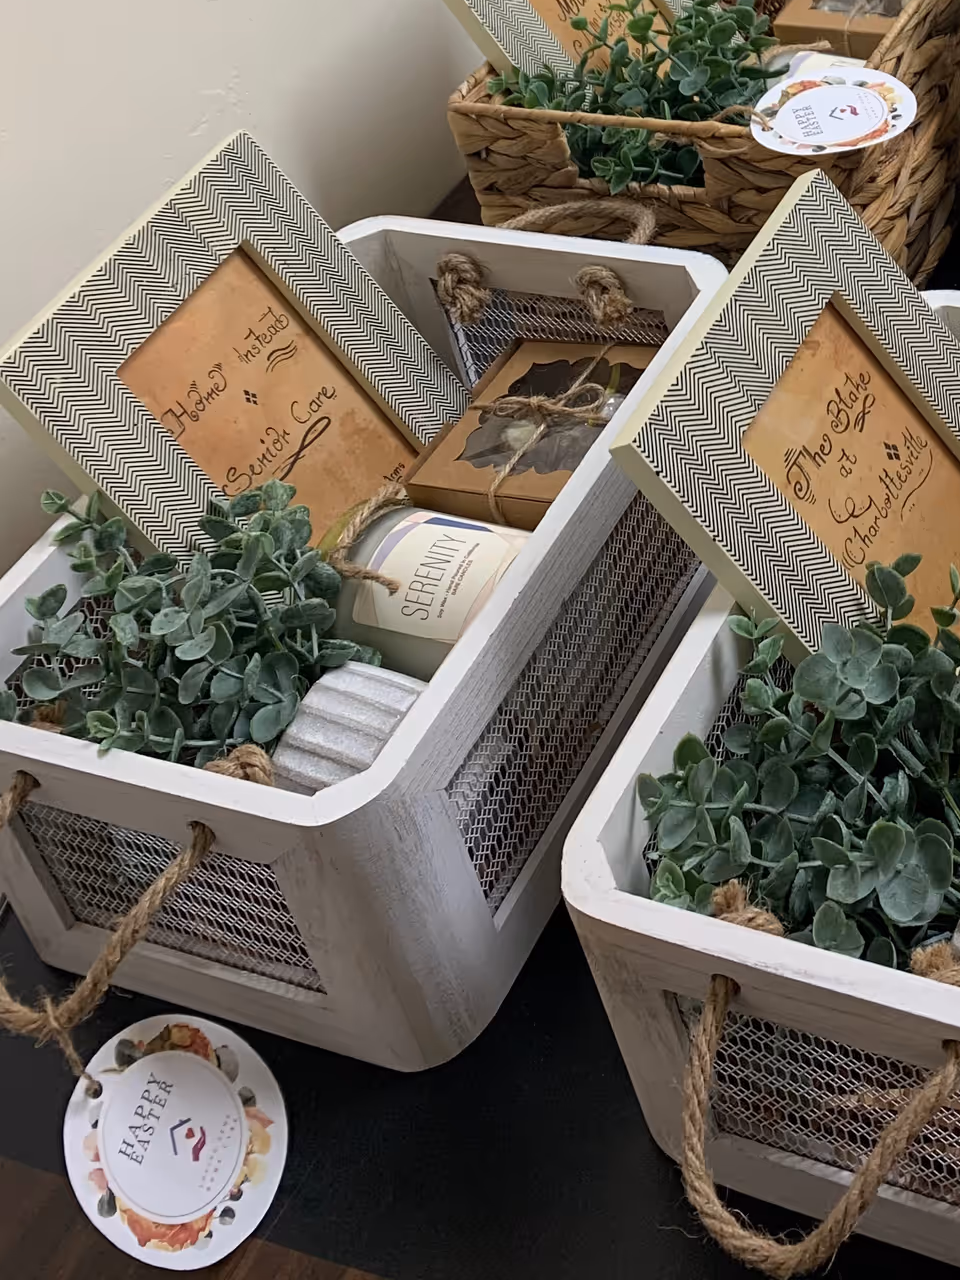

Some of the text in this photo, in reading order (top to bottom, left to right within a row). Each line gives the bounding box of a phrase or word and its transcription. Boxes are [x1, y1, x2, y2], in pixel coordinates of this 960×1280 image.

[792, 107, 813, 137] HAPPY
[802, 105, 824, 135] EASTER
[160, 306, 290, 440] Home Instead
[222, 386, 336, 496] Senior Care
[785, 371, 871, 501] The Blake
[839, 448, 858, 478] at
[401, 533, 466, 620] SERENITY
[118, 1072, 161, 1159] HAPPY
[129, 1080, 174, 1166] EASTER
